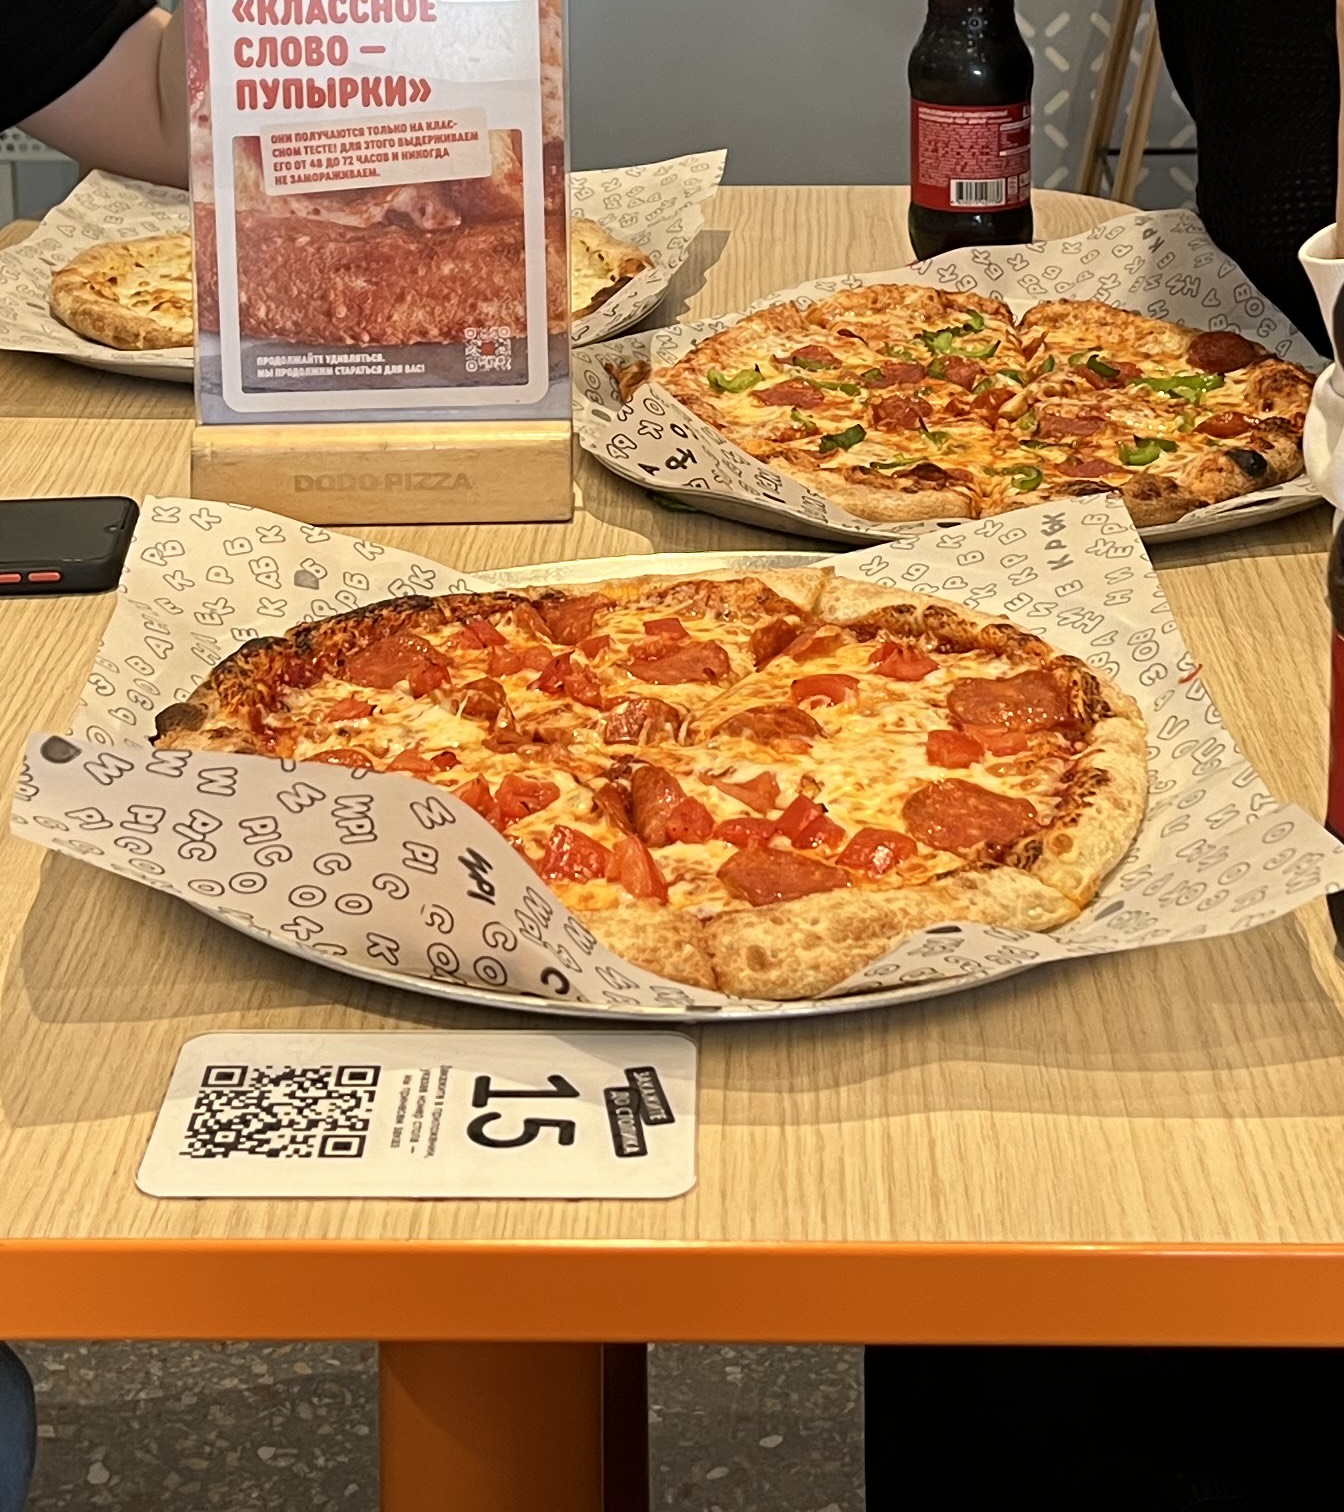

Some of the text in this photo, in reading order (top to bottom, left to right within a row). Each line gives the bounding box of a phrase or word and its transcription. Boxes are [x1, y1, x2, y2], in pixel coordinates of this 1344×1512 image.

[233, 34, 349, 68] СЛОВО
[235, 74, 432, 110] ПУПЫРКИ»
[270, 119, 458, 144] ОНИ ПОЛУЧАЮТСЯ ТОЛЬКО НА КЛАС-
[272, 130, 479, 158] СНОМ ТЕСТЕ! ДЛЯ ЭТОГО ВЫДЕРЖИВАЕМ
[273, 146, 450, 172] ЕГО ОТ 48 ДО 72 ЧАСОВ И НИКОГДА
[274, 168, 381, 186] НЕ ЗАМОРАЖИВАЕМ.
[257, 368, 274, 378] МЫ
[335, 365, 383, 376] СТАРАТЬСЯ
[384, 365, 404, 376] ДЛЯ
[405, 363, 426, 374] ВАС!
[294, 472, 473, 493] DODO PIZZA
[467, 1074, 581, 1149] 15
